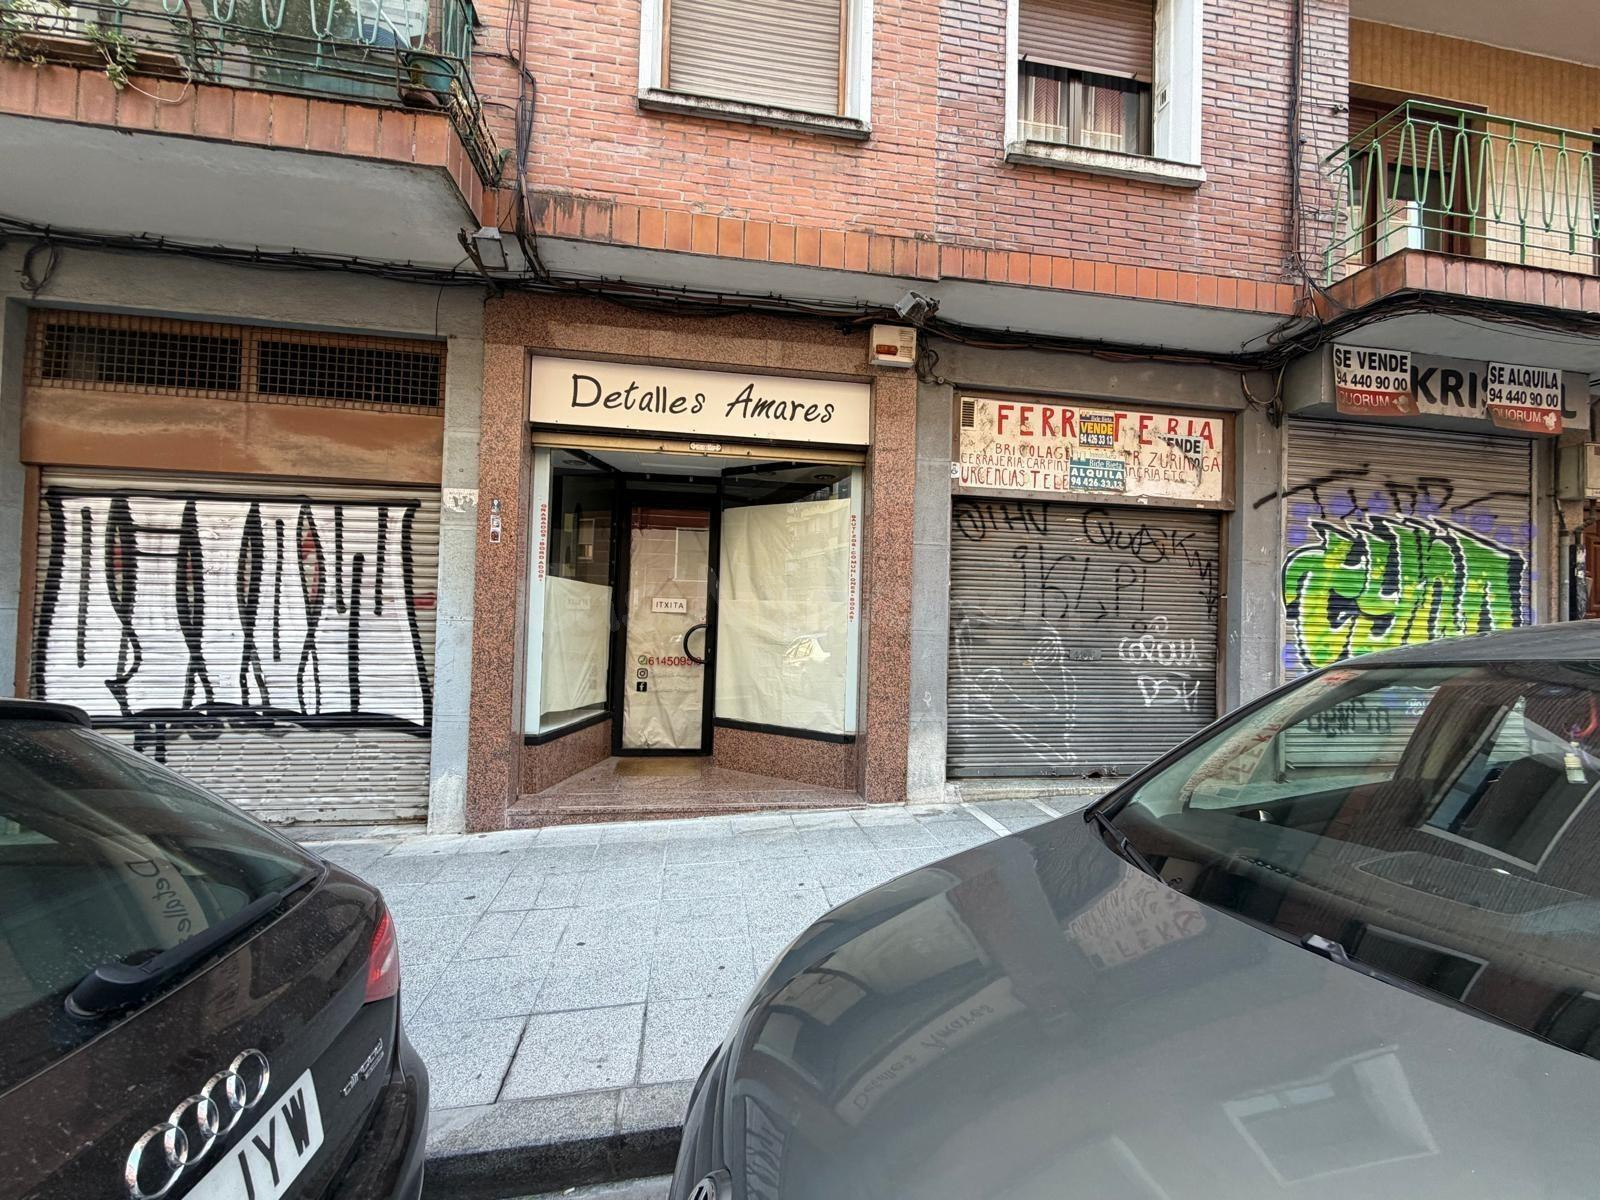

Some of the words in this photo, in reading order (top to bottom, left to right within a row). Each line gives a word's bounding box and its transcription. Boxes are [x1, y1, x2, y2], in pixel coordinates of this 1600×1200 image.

[1335, 348, 1351, 368] SE
[1357, 351, 1408, 373] VENDE
[1336, 371, 1347, 386] 94
[1351, 374, 1372, 388] 440
[1375, 376, 1390, 389] 90
[1393, 377, 1408, 391] 00
[1489, 366, 1504, 385] SE
[1508, 368, 1558, 390] ALQUILA
[571, 374, 706, 414] Detalles
[725, 383, 835, 423] Amares
[1489, 388, 1503, 403] 94
[1506, 389, 1526, 405] 440
[1530, 392, 1542, 406] 90
[1546, 393, 1558, 407] 00
[997, 405, 1214, 449] FERRTERIA
[1081, 422, 1113, 435] VENDE
[1071, 468, 1123, 479] ALQUILA
[1071, 476, 1081, 485] 94
[656, 601, 684, 609] ITXITA
